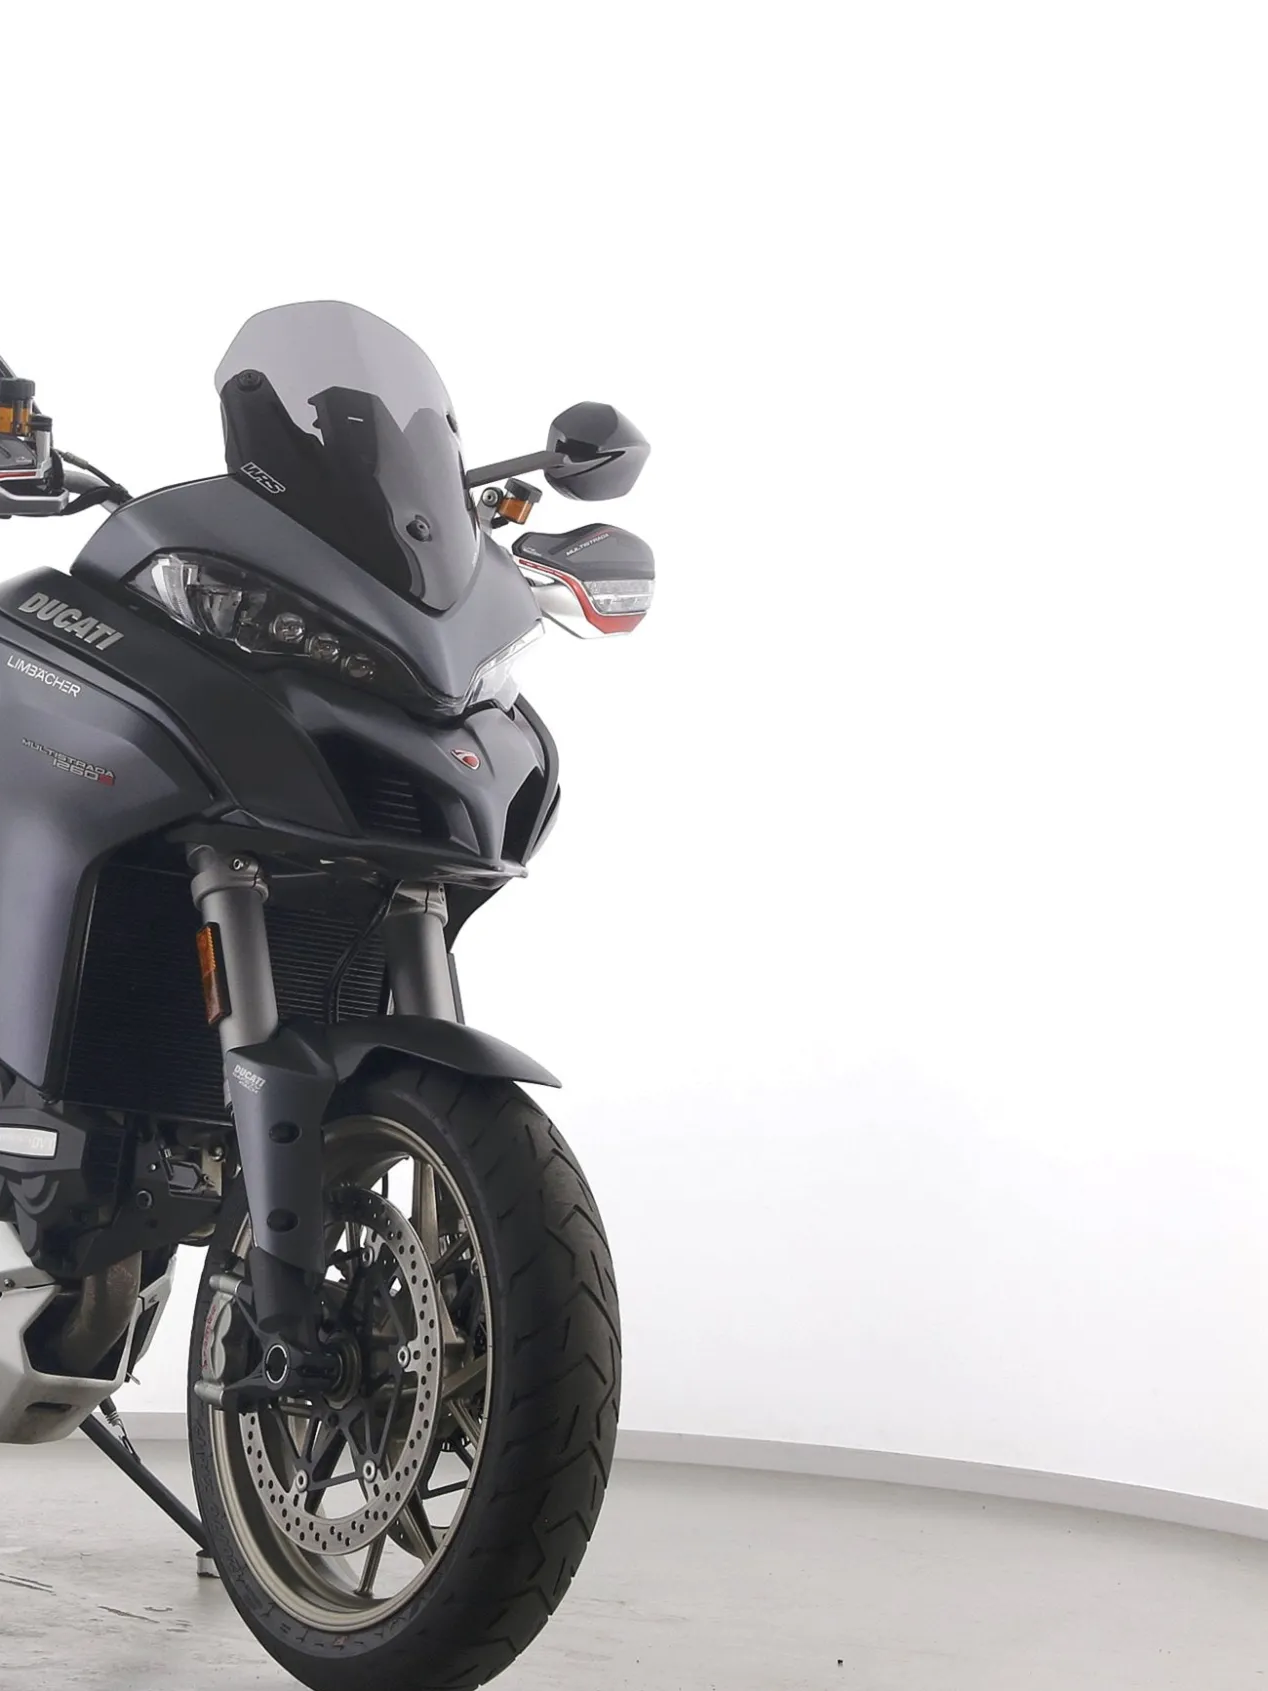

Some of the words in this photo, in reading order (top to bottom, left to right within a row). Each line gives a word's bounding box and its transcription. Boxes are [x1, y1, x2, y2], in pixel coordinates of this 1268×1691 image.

[240, 461, 286, 494] WRS
[17, 592, 125, 651] DUCATI
[21, 737, 115, 778] MULTISTRADA
[233, 1064, 267, 1088] DUCATI
